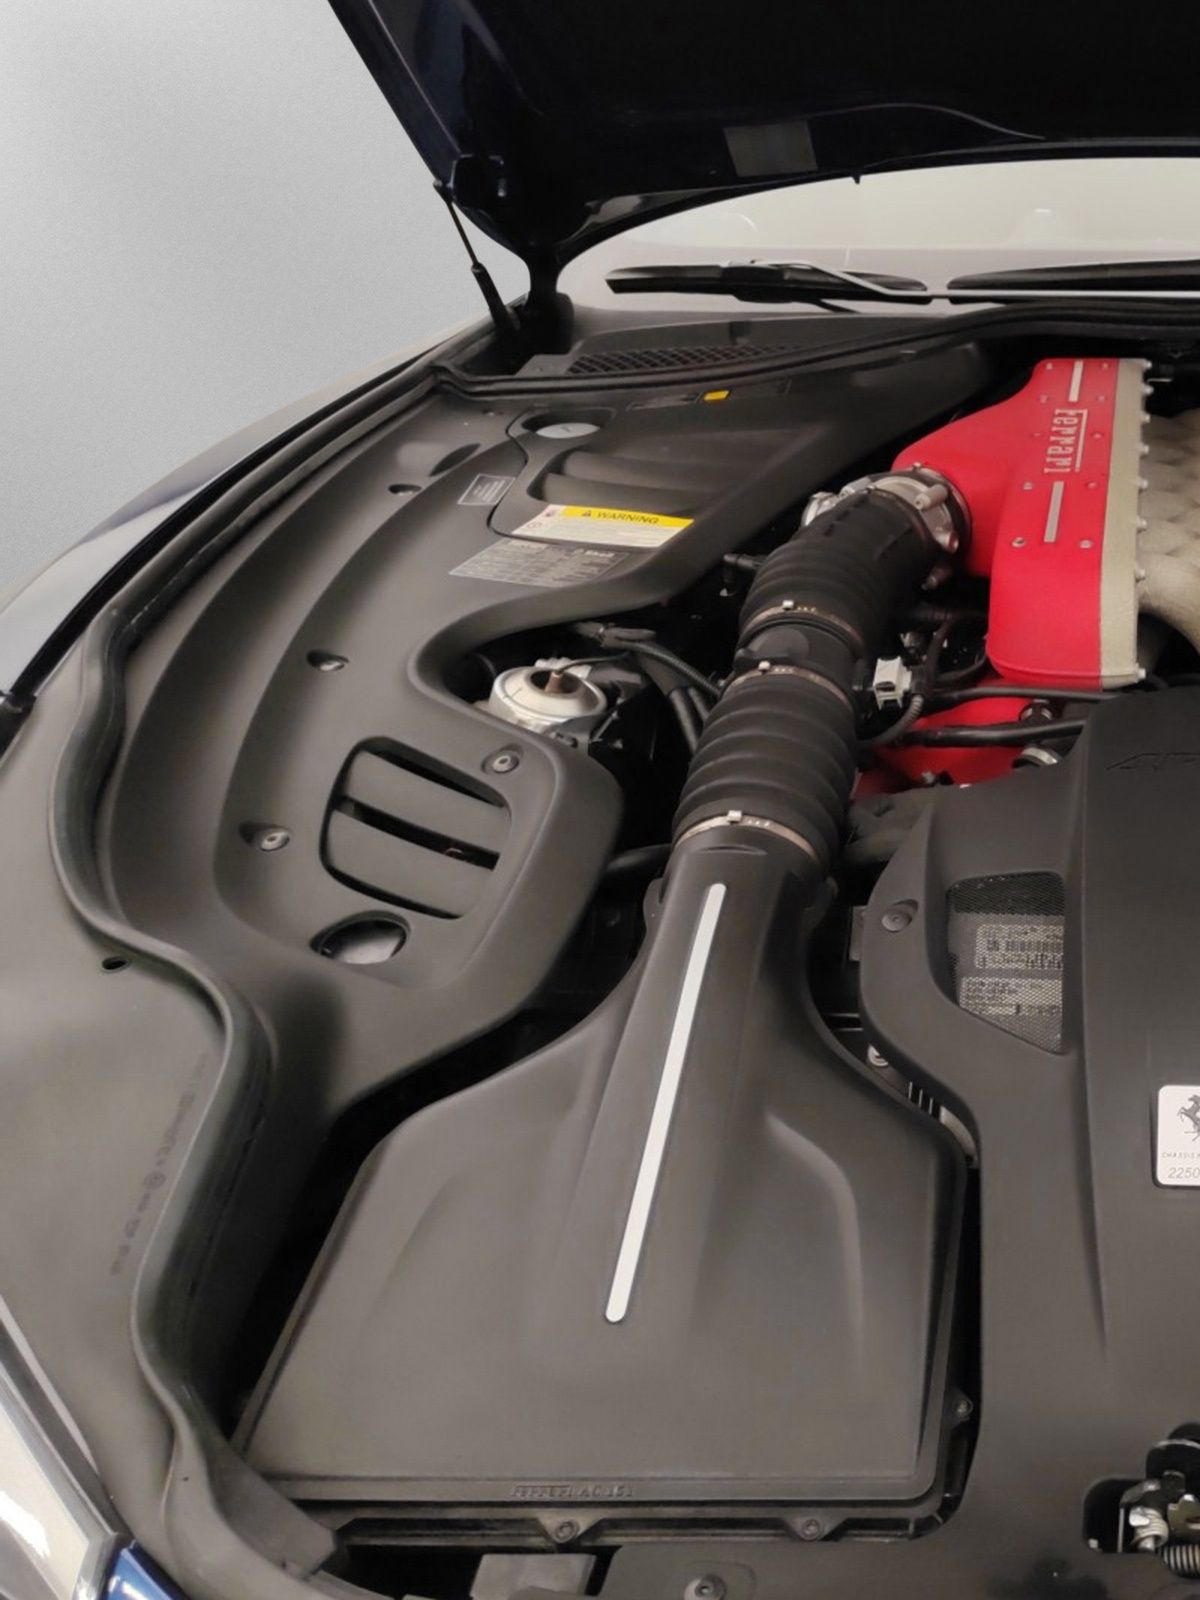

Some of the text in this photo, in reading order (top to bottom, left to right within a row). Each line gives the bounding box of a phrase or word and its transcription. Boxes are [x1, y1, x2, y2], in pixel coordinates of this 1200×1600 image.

[1043, 408, 1088, 473] Ferrari
[597, 510, 660, 524] WARNING
[1162, 1151, 1196, 1159] CHASSIS
